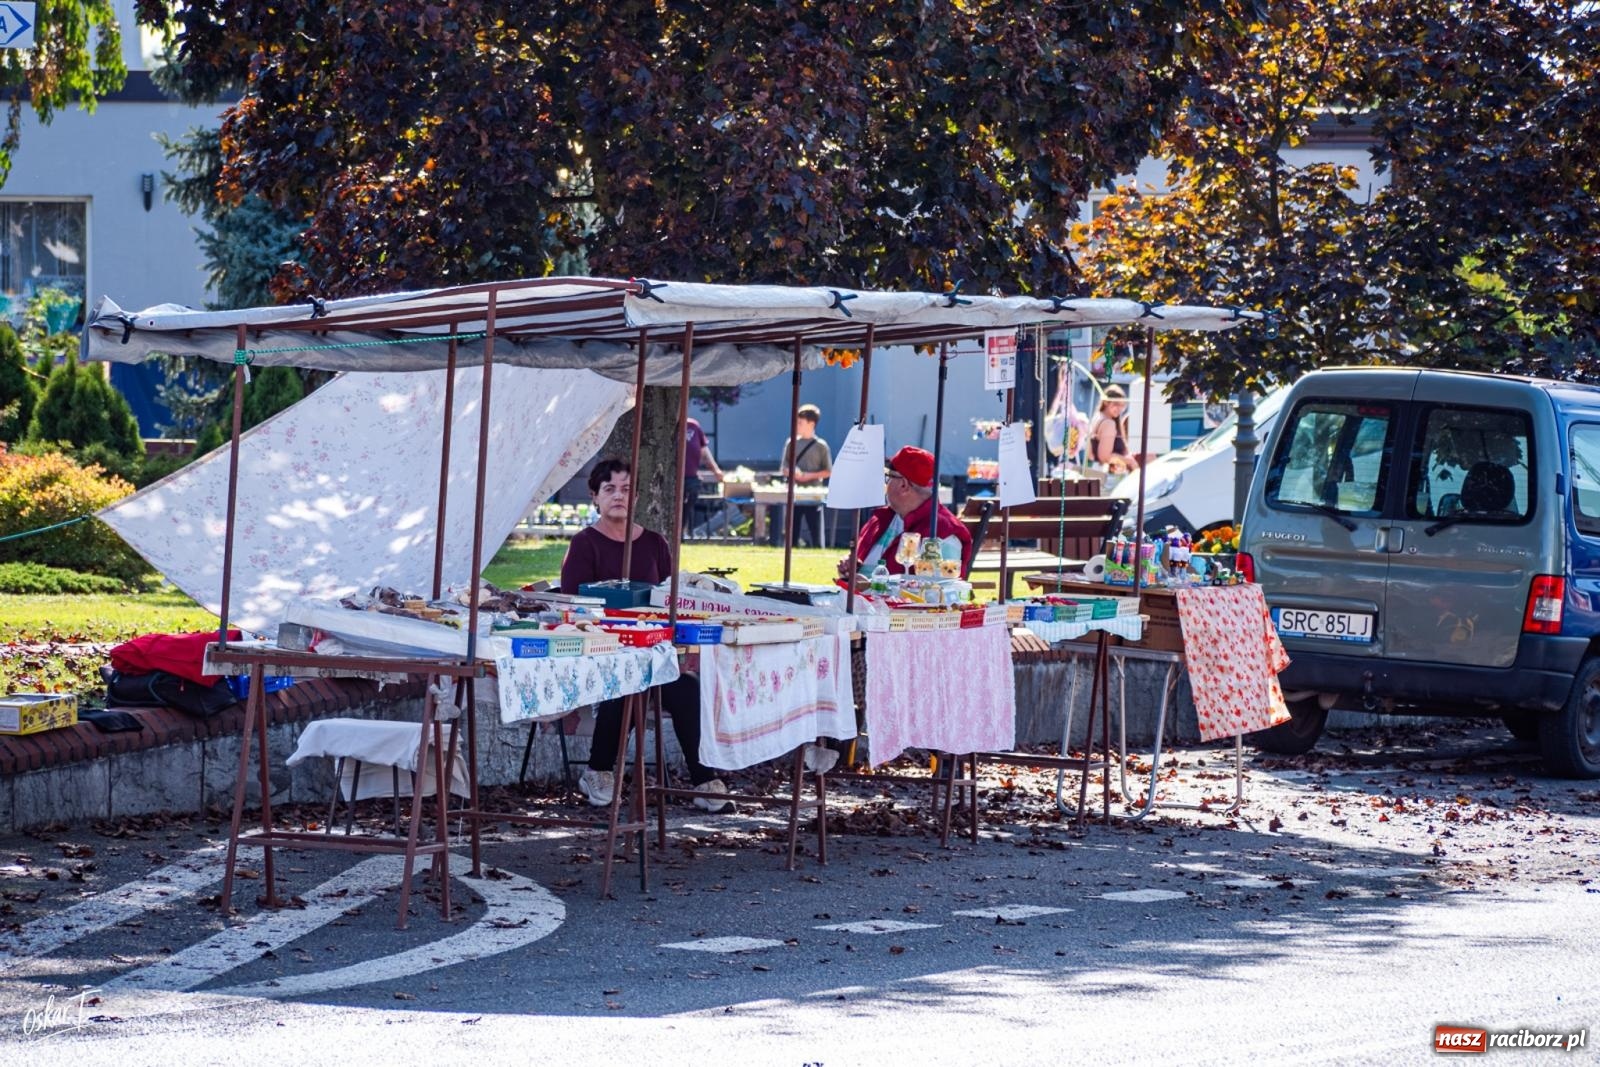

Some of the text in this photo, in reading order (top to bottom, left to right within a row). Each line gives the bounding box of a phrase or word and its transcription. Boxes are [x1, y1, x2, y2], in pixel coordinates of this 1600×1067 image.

[1261, 531, 1306, 541] PEUGEOT
[1282, 610, 1369, 636] SRC 85LJ
